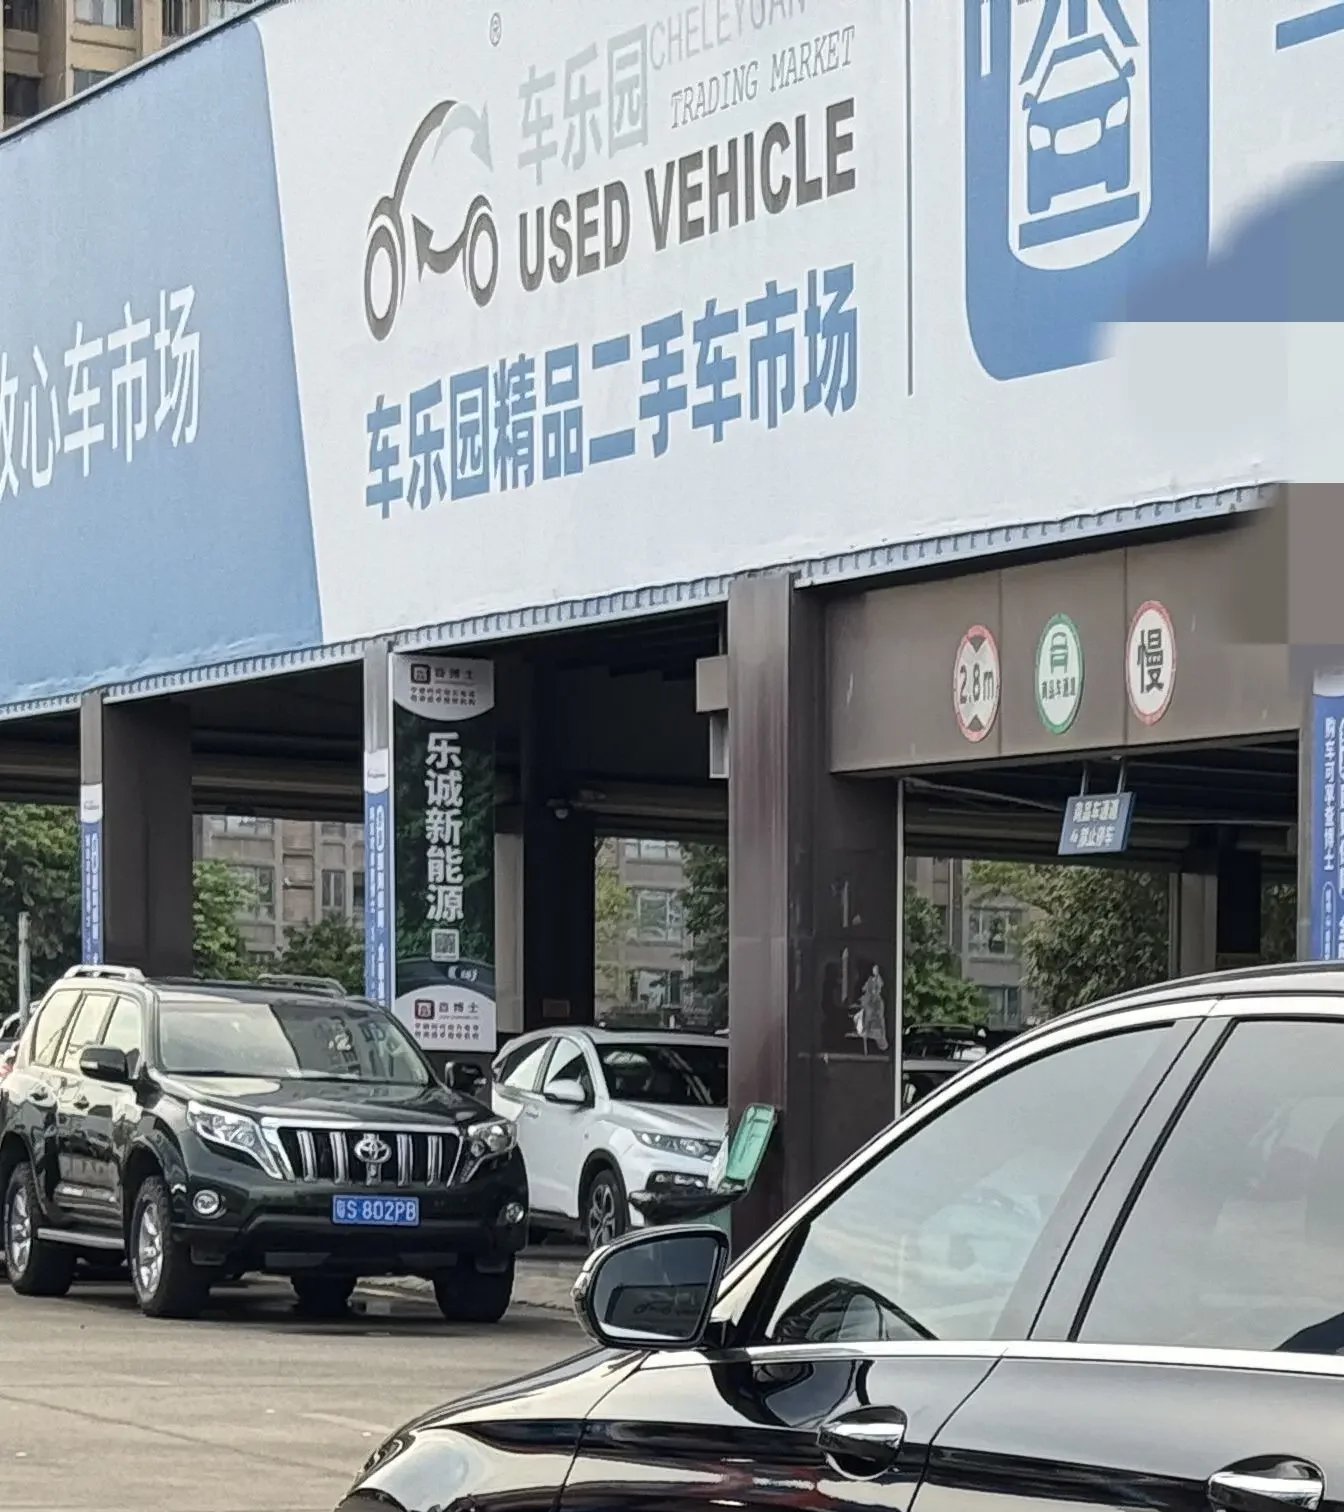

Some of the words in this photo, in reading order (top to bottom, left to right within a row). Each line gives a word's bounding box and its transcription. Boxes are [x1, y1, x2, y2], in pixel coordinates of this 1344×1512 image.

[517, 23, 649, 187] 车乐园
[671, 61, 760, 130] TRADING
[769, 24, 856, 94] MARKET
[519, 179, 631, 293] USED
[645, 97, 856, 253] VEHICLE
[366, 262, 859, 520] 车乐园精品二手车市场
[959, 662, 995, 705] 2.8m
[1137, 628, 1165, 695] 慢
[424, 731, 465, 922] 乐诚新能源
